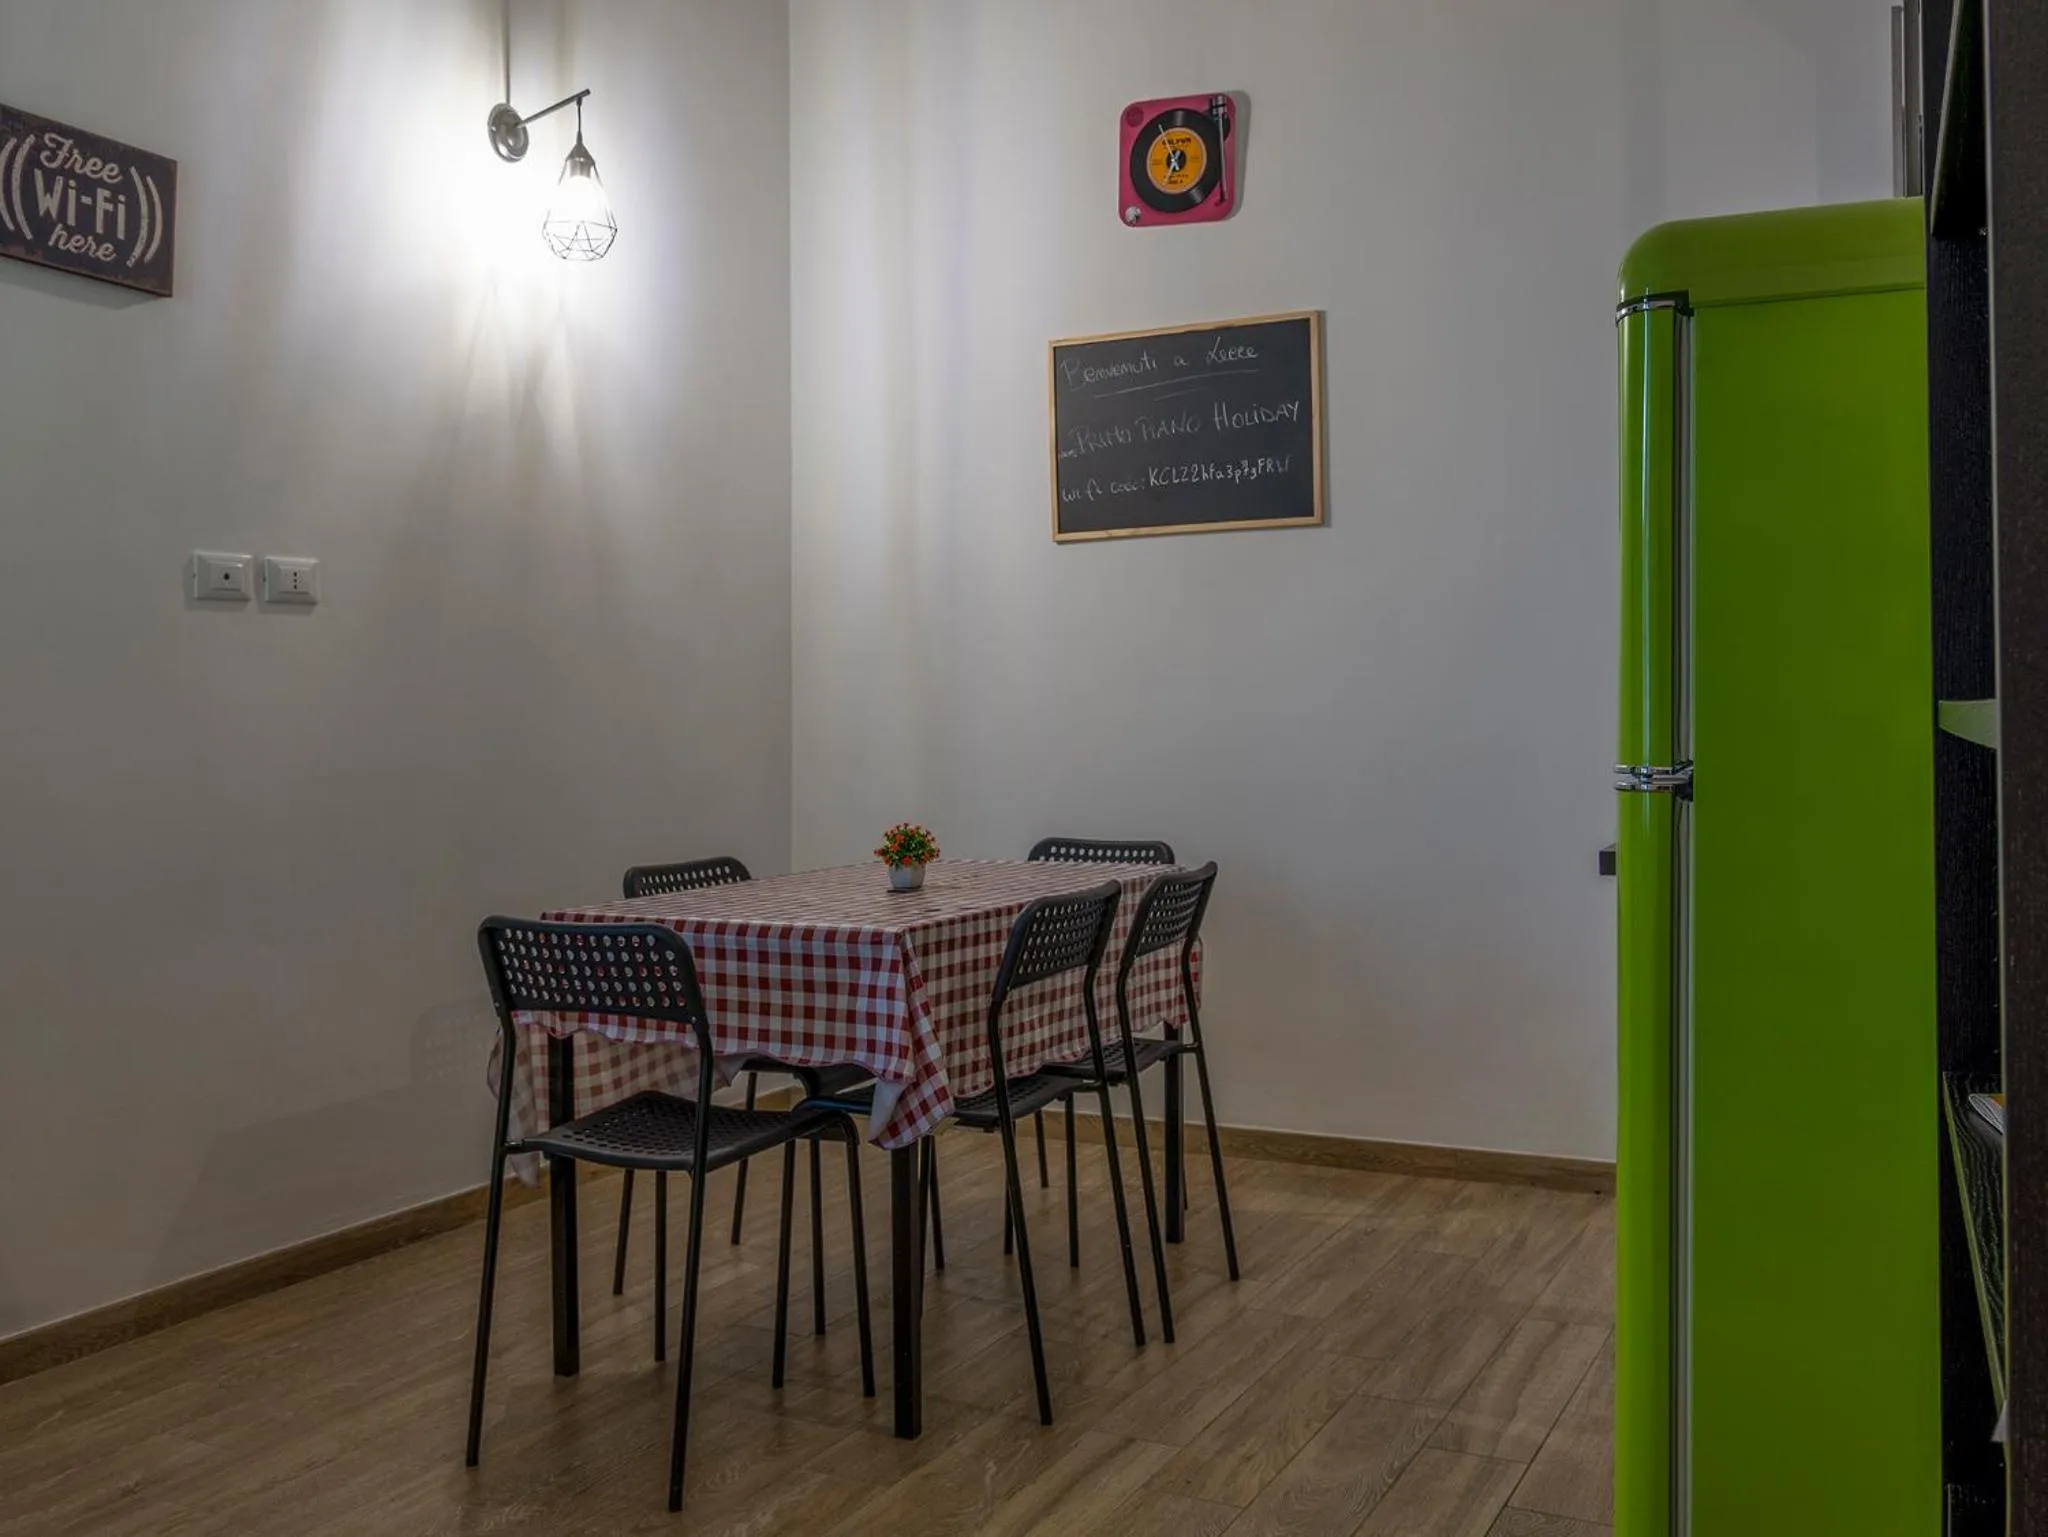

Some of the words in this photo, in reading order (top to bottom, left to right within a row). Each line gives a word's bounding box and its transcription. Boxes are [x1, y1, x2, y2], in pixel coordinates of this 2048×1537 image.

[39, 131, 124, 184] Free
[33, 167, 127, 241] Wi-Fi
[48, 222, 117, 262] here
[1173, 355, 1189, 368] a
